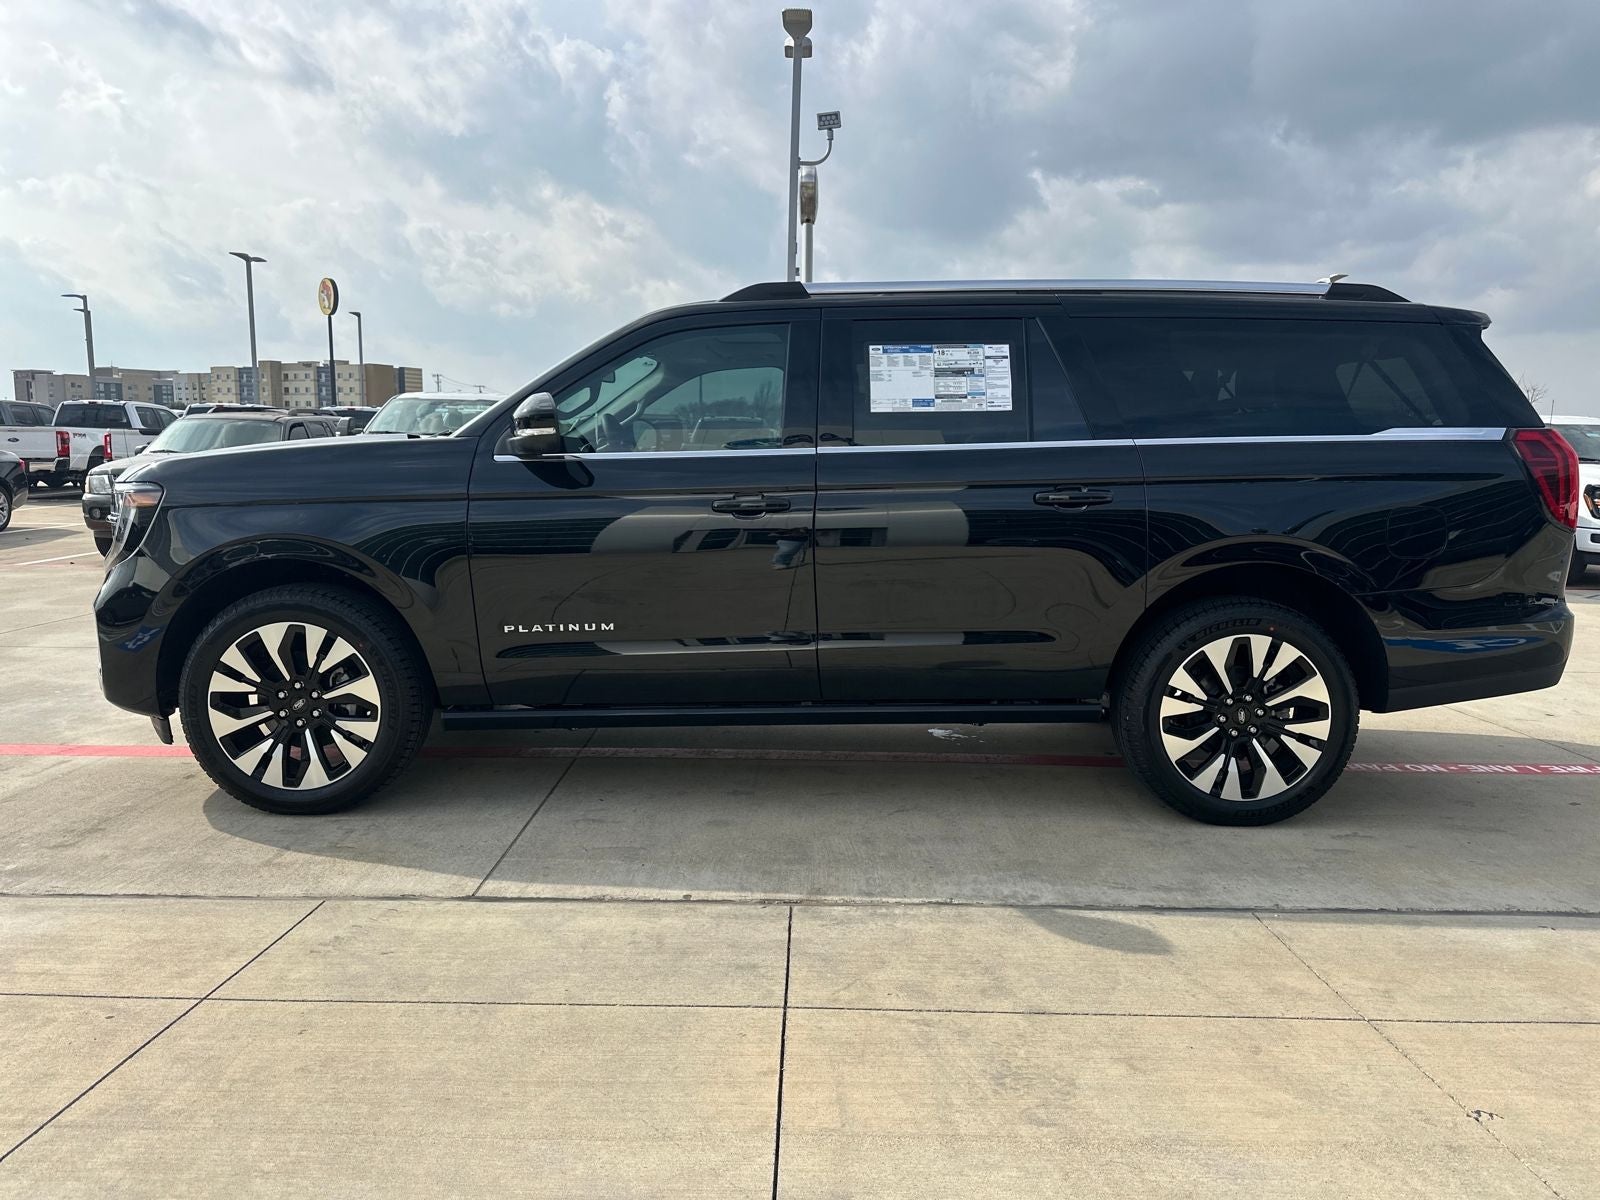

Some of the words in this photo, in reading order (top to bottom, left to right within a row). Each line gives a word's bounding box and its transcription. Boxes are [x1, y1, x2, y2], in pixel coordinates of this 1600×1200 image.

[503, 622, 615, 633] PLATINUM
[1403, 763, 1449, 773] NO
[1458, 764, 1542, 773] LANE
[1545, 764, 1600, 774] FIRE
